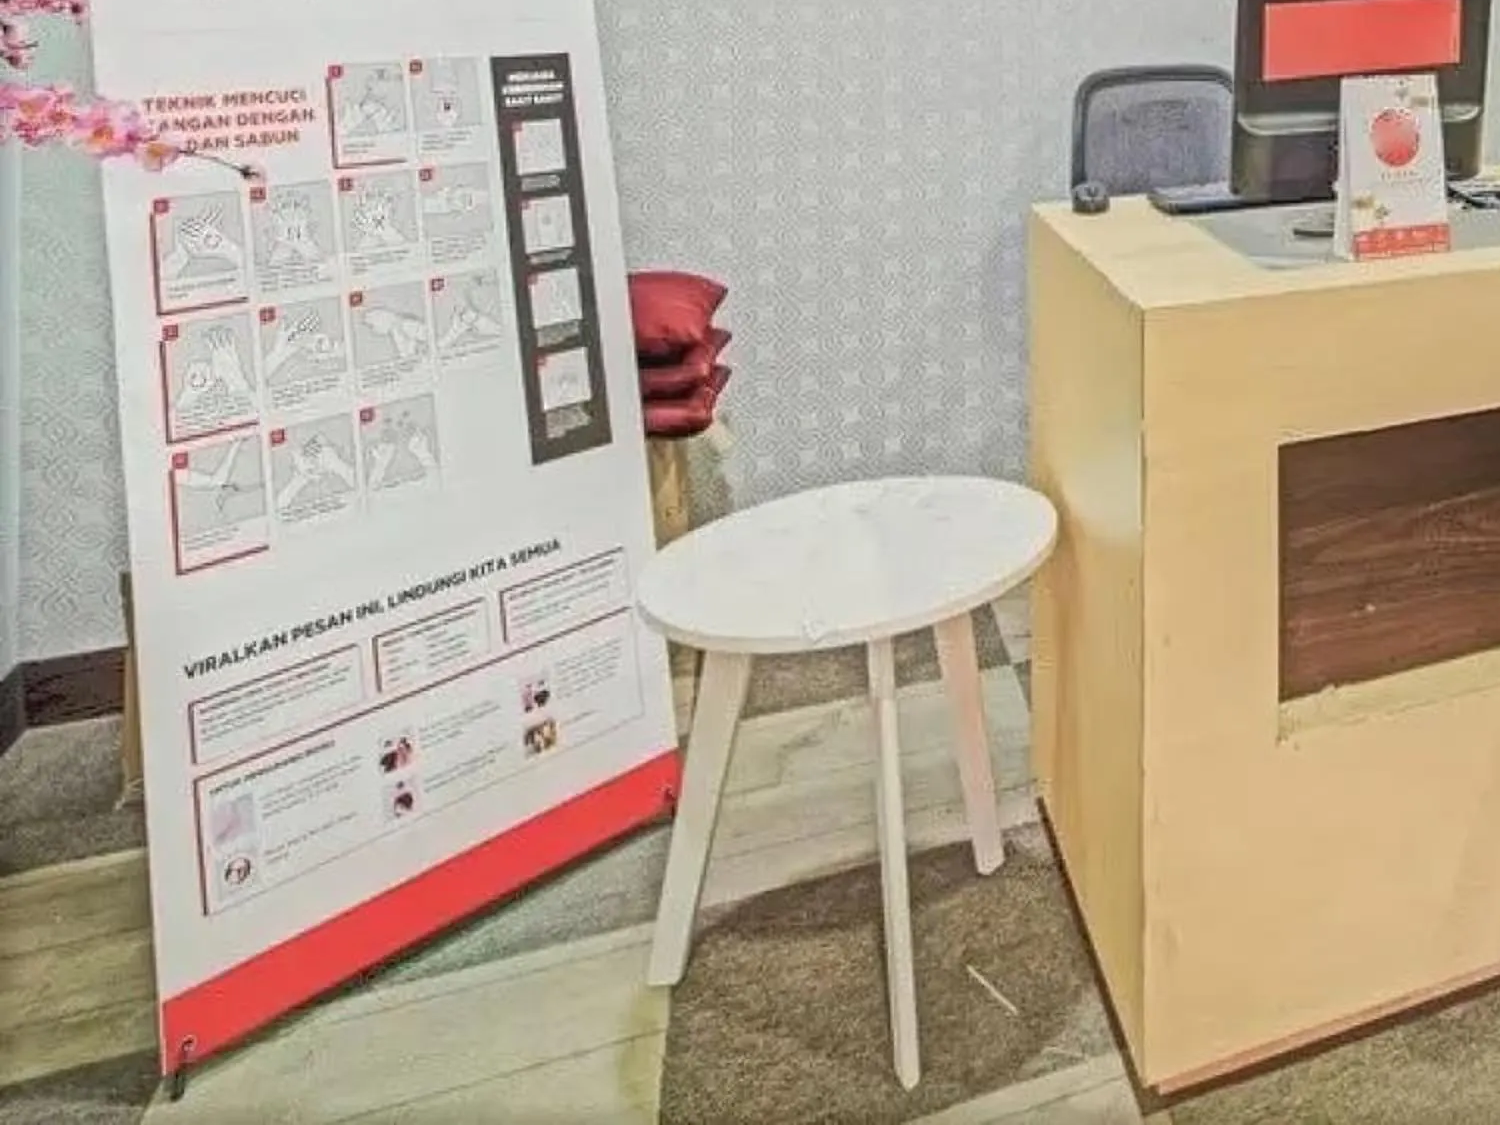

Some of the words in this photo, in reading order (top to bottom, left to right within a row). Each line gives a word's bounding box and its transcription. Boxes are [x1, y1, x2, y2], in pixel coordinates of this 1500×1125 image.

[143, 94, 217, 113] TEKNIK
[222, 89, 307, 107] MENCUCI
[237, 107, 315, 126] DENGAN
[233, 129, 301, 149] SABUN
[183, 631, 289, 679] VIRALKAN
[290, 609, 353, 642] PESAN
[387, 567, 467, 608] LINDUNGI
[510, 538, 561, 567] SEMUA
